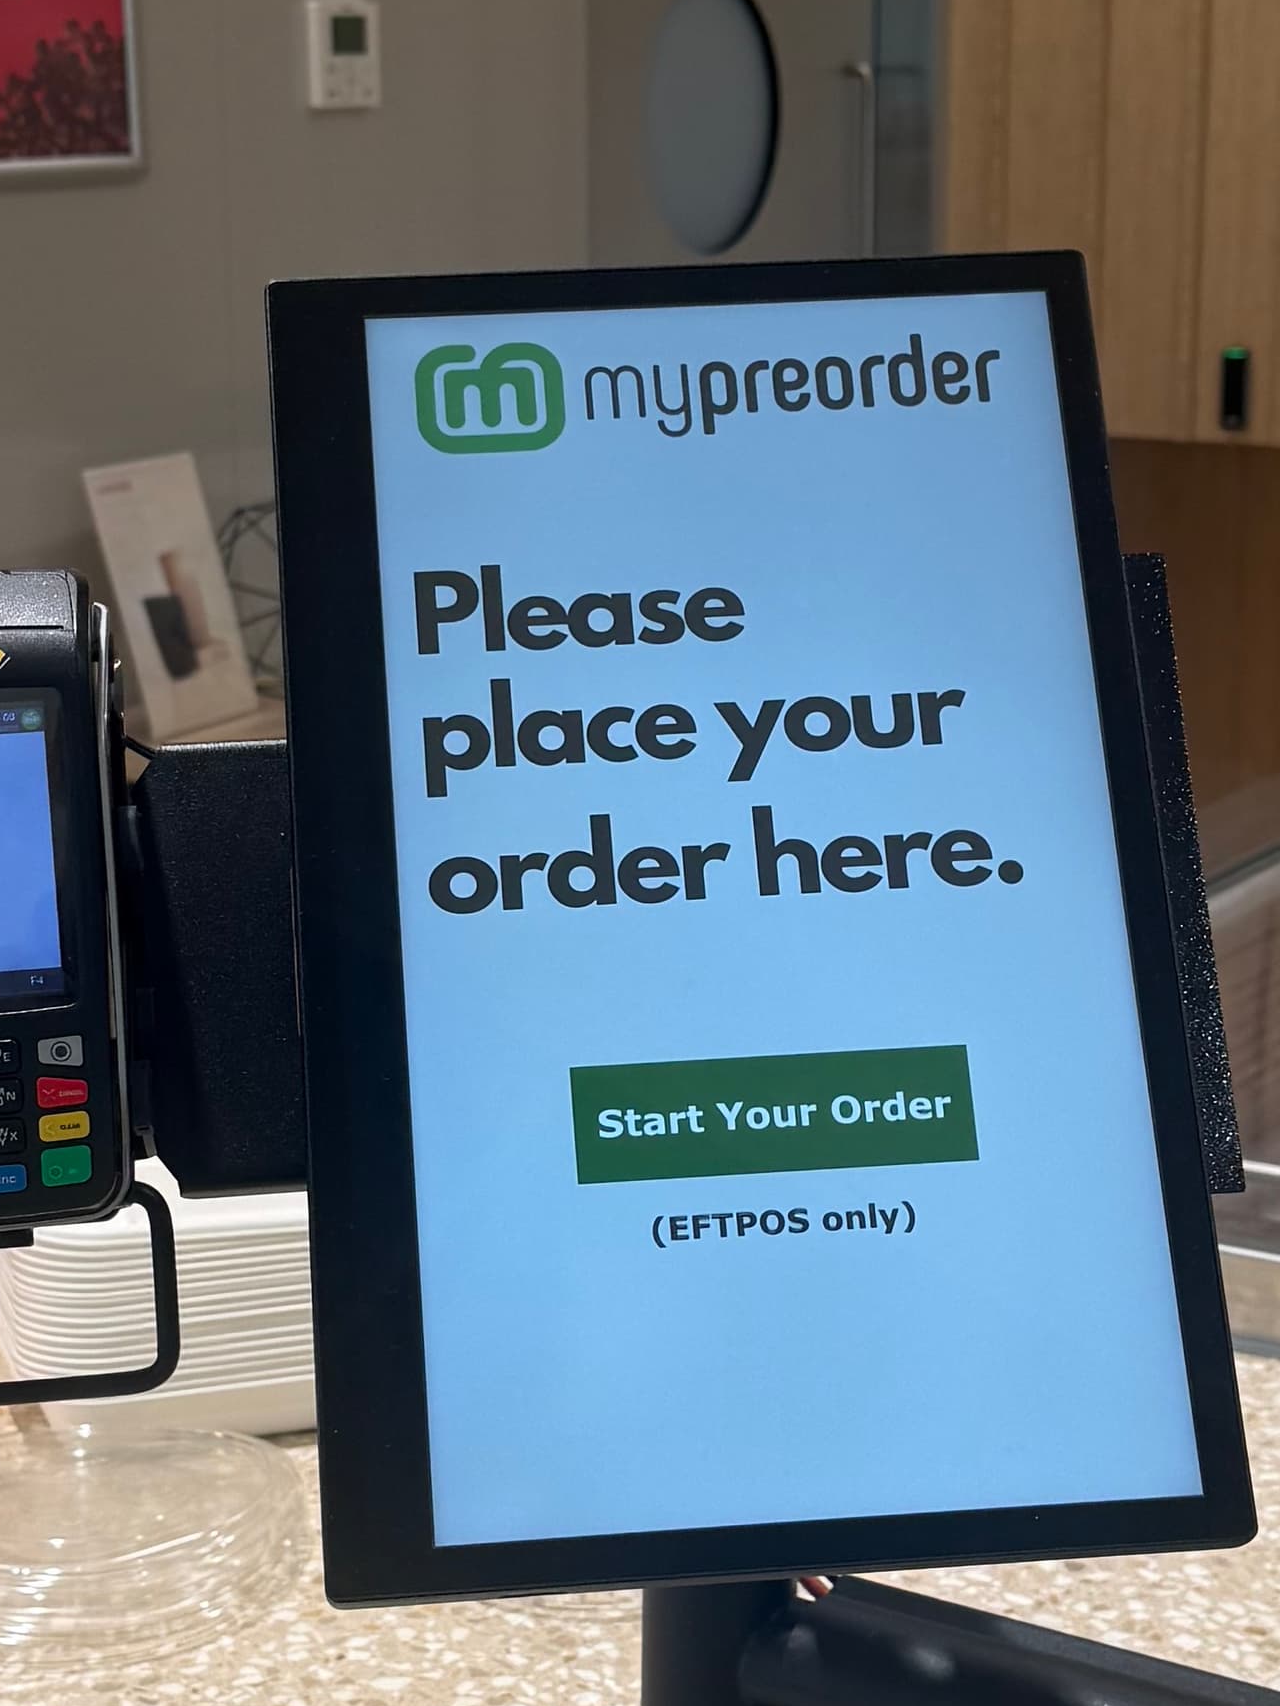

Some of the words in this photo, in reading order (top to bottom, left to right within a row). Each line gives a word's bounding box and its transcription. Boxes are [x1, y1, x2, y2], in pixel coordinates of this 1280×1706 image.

[583, 332, 1001, 438] mypreorder
[413, 564, 746, 656] Please
[421, 677, 698, 798] place
[713, 689, 967, 783] your
[427, 813, 732, 915] order
[751, 804, 1025, 897] here.
[29, 974, 45, 986] F4
[597, 1103, 706, 1139] Start
[715, 1099, 818, 1131] Your
[830, 1091, 952, 1125] Order
[652, 1208, 810, 1248] (EFTPOS
[822, 1201, 917, 1234] only)
